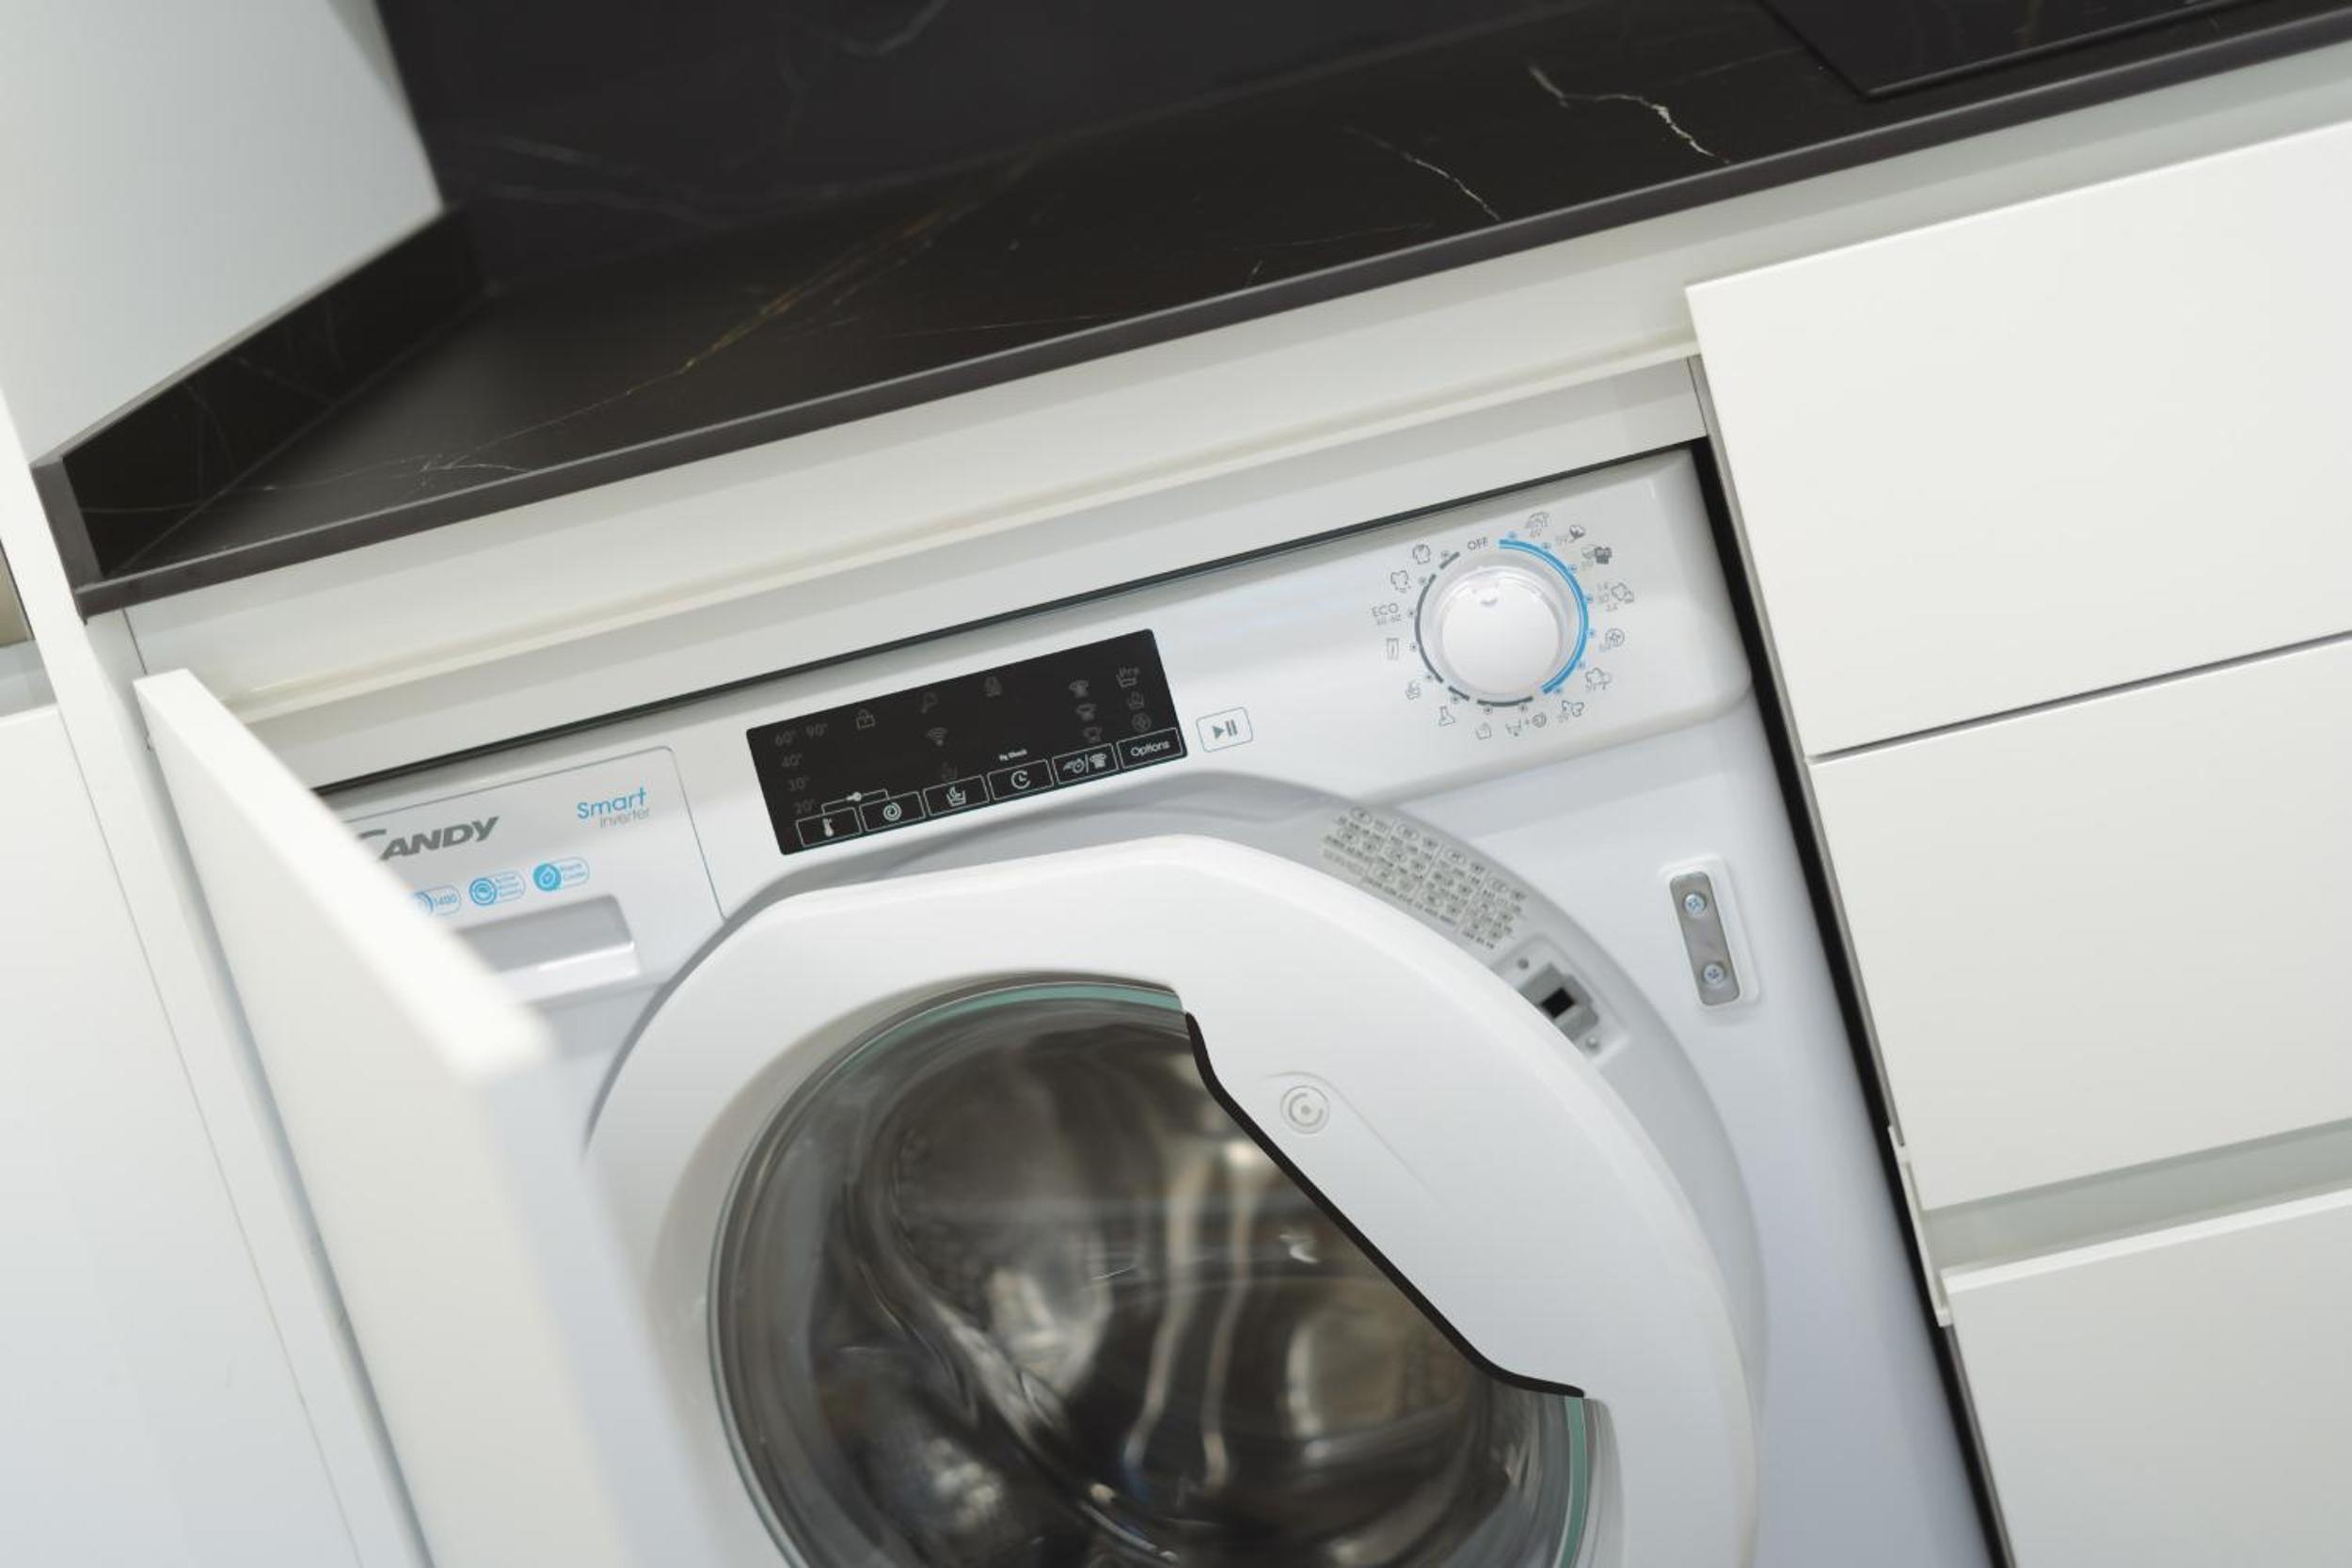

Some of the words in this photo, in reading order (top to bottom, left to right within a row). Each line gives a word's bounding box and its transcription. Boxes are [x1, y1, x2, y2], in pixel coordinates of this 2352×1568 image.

[1467, 536, 1489, 551] OFF
[1372, 602, 1399, 617] ECO
[1130, 741, 1169, 756] Options
[577, 786, 647, 819] Smart
